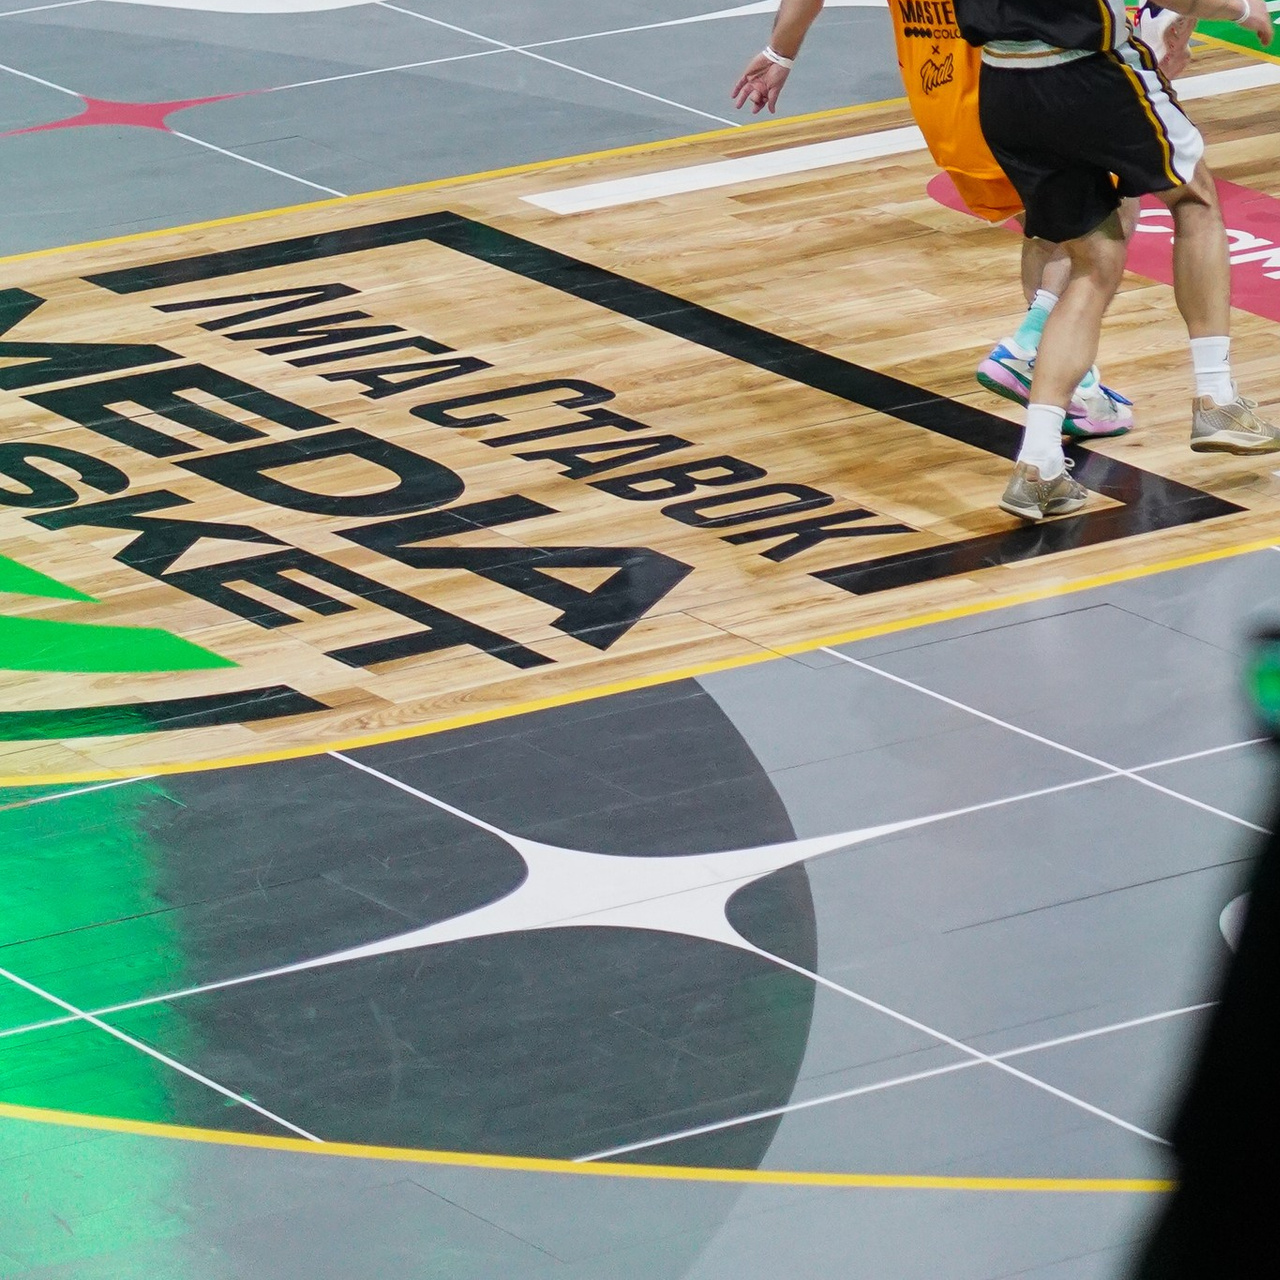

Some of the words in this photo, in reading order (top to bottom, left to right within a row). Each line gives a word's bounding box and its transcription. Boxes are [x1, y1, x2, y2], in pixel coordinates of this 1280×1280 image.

[152, 282, 496, 400] ЛИГА
[408, 378, 922, 564] СТАВОК
[0, 441, 558, 670] SKET
